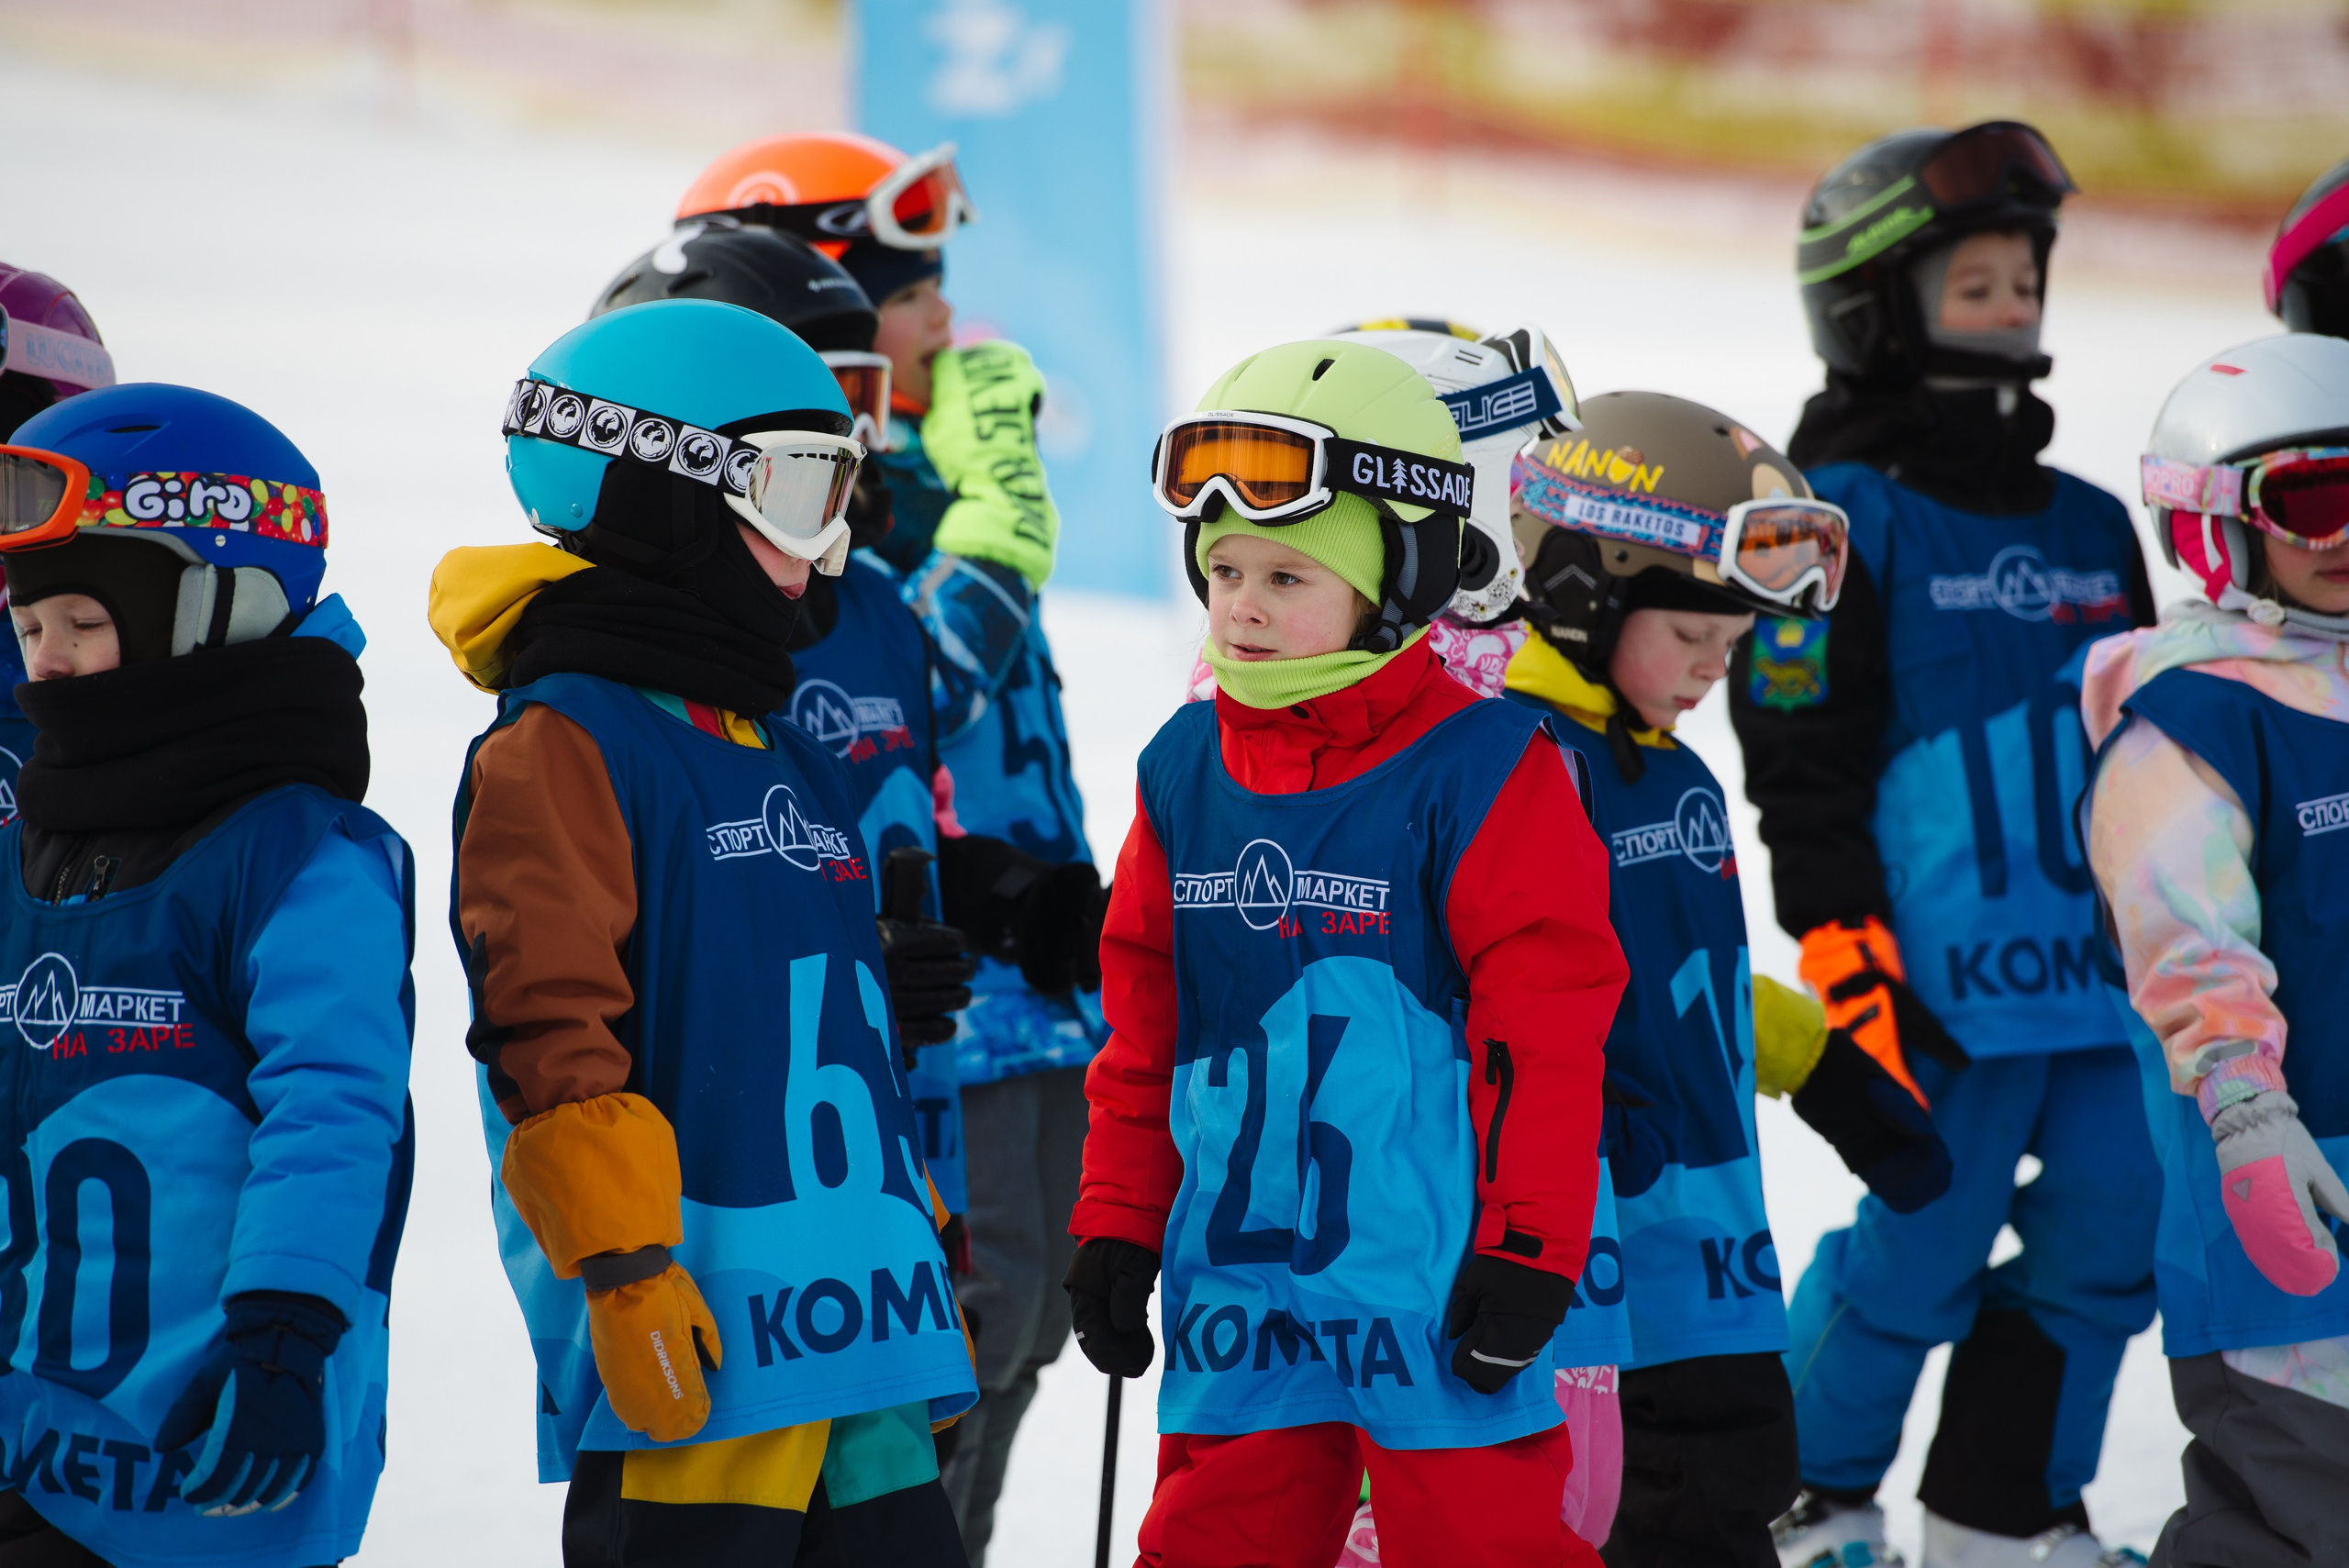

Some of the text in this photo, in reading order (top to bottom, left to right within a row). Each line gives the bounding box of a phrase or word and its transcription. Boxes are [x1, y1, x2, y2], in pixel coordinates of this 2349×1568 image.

[123, 476, 252, 523] Giro
[1577, 502, 1686, 538] LOS RAKETOS
[707, 825, 765, 855] СПОРТ
[1613, 828, 1677, 862] СПОРТ
[1174, 876, 1390, 911] СПОРТ МАРКЕТ
[1321, 911, 1390, 935] ЗАРЕ
[80, 995, 185, 1022] МАРКЕТ
[52, 1023, 195, 1061] НА ЗАРЕ
[1206, 1013, 1353, 1276] 26
[1165, 1303, 1415, 1389] КОМТА
[650, 1330, 684, 1400] DIDRIKSONS
